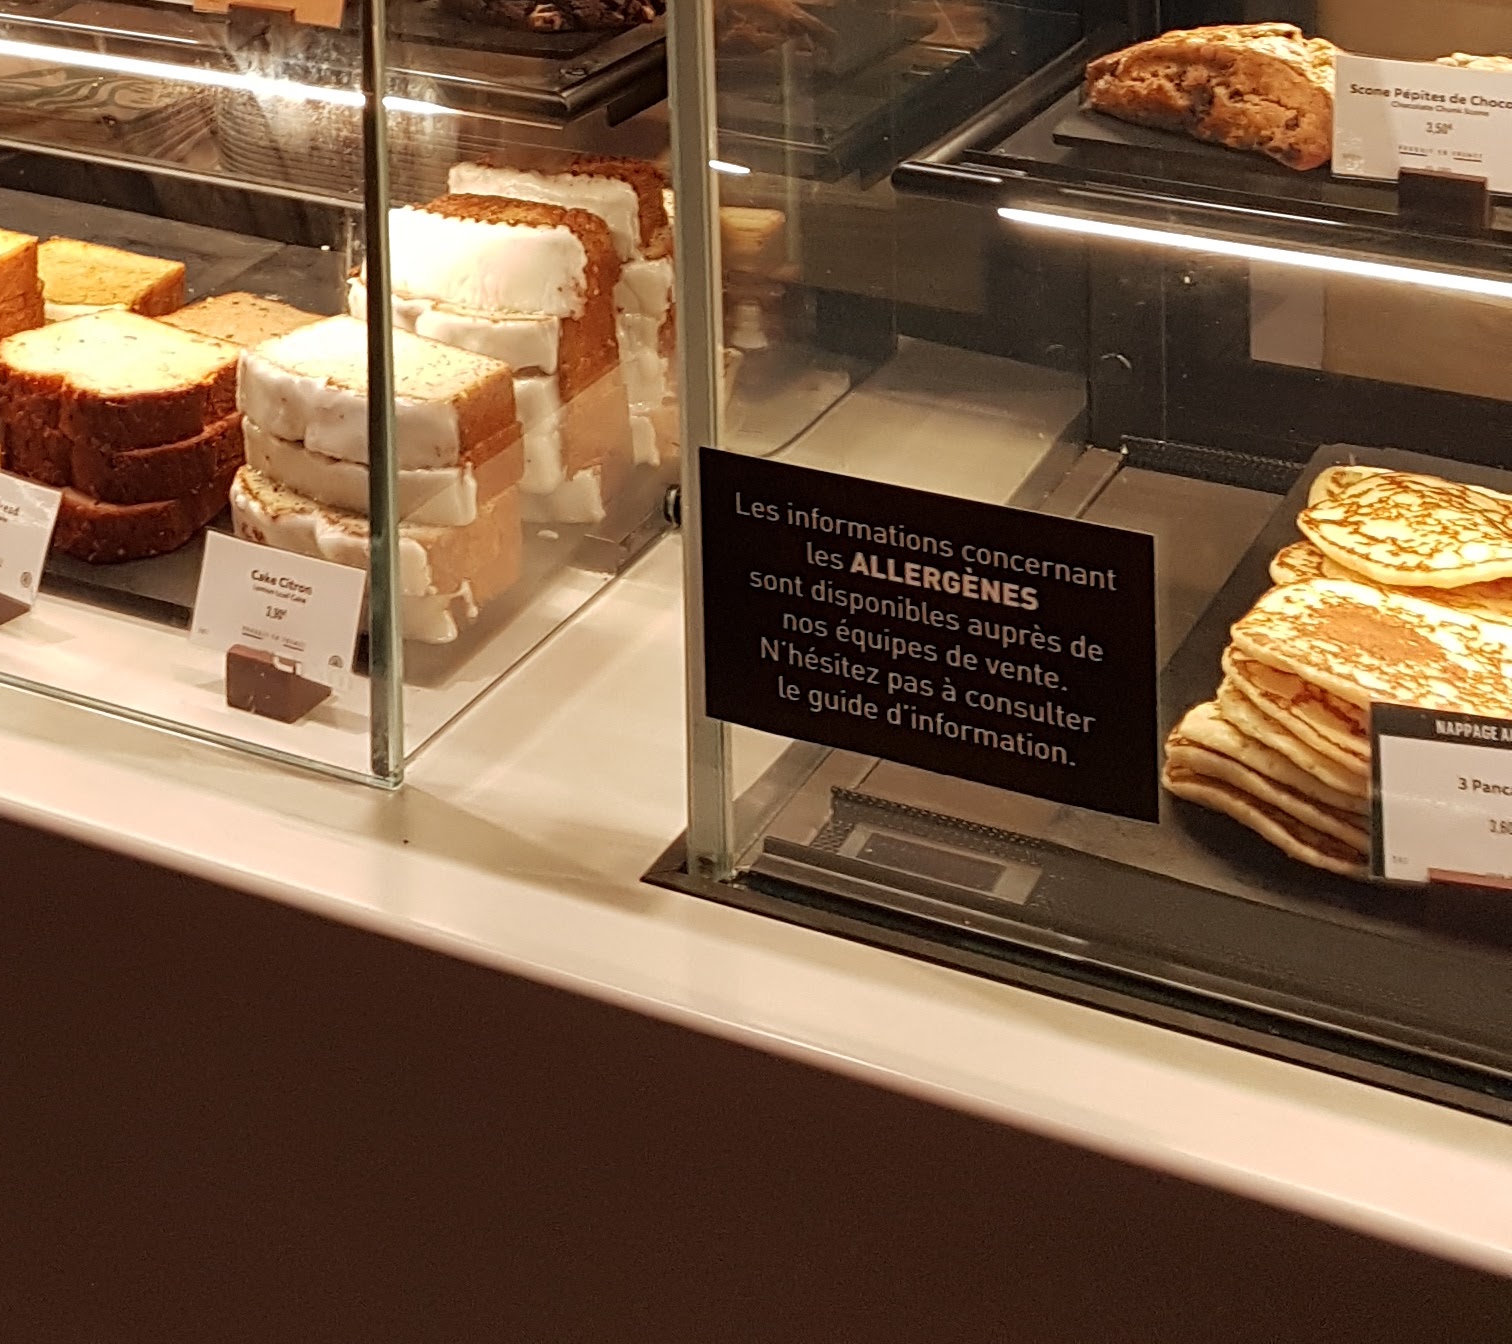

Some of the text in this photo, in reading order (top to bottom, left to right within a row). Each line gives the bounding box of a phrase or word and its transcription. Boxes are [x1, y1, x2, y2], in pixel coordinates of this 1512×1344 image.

[1350, 84, 1389, 97] Scone
[1449, 94, 1467, 105] de
[735, 491, 1117, 591] Les informations concernant
[806, 543, 1038, 611] les ALLERGÈNES
[251, 570, 277, 586] Cake
[279, 577, 312, 595] Citron
[750, 572, 1103, 662] sont disponibles auprès de
[760, 636, 1096, 733] N'hésitez pas à consulter
[783, 613, 1068, 692] nos équipes de vente.
[778, 676, 1076, 767] le guide d'information.
[1435, 720, 1498, 741] NAPPAGE
[1458, 777, 1468, 790] 3
